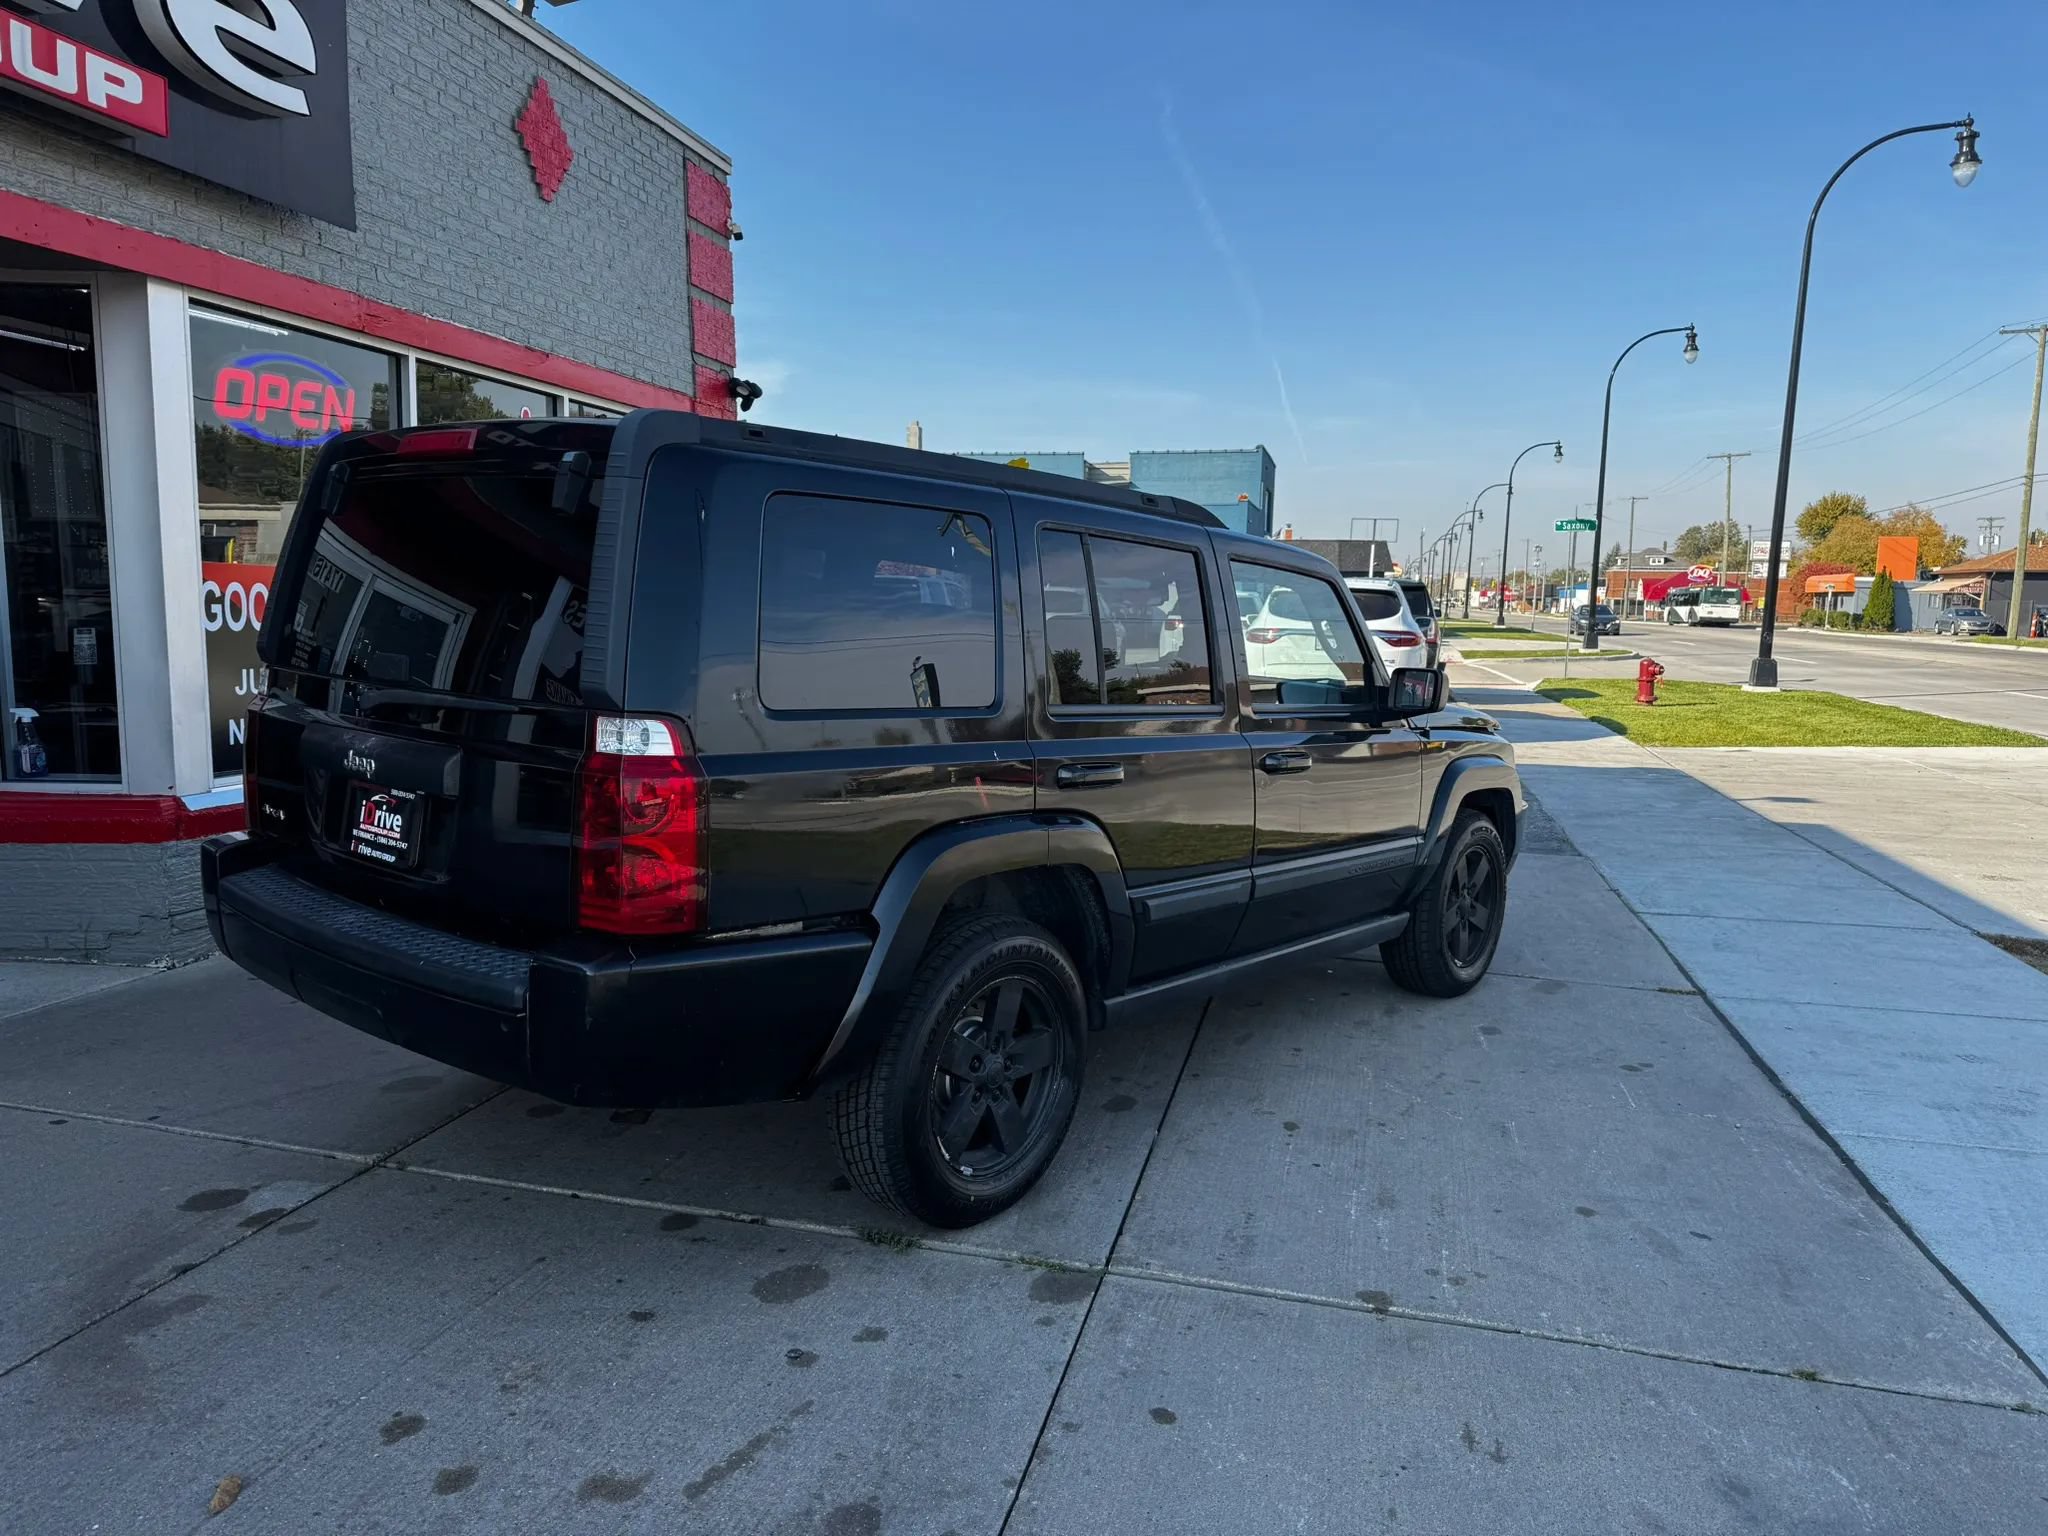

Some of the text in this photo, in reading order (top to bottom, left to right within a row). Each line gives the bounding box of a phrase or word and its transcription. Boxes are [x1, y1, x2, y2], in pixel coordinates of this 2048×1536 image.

[0, 19, 142, 108] UP
[213, 367, 356, 432] OPEN
[1562, 521, 1590, 531] Saxony
[1692, 567, 1711, 578] DQ
[344, 749, 375, 779] Jeep
[360, 799, 402, 833] iDrive
[358, 829, 375, 841] FINANCE
[360, 822, 401, 840] AUTOGROUP.COM
